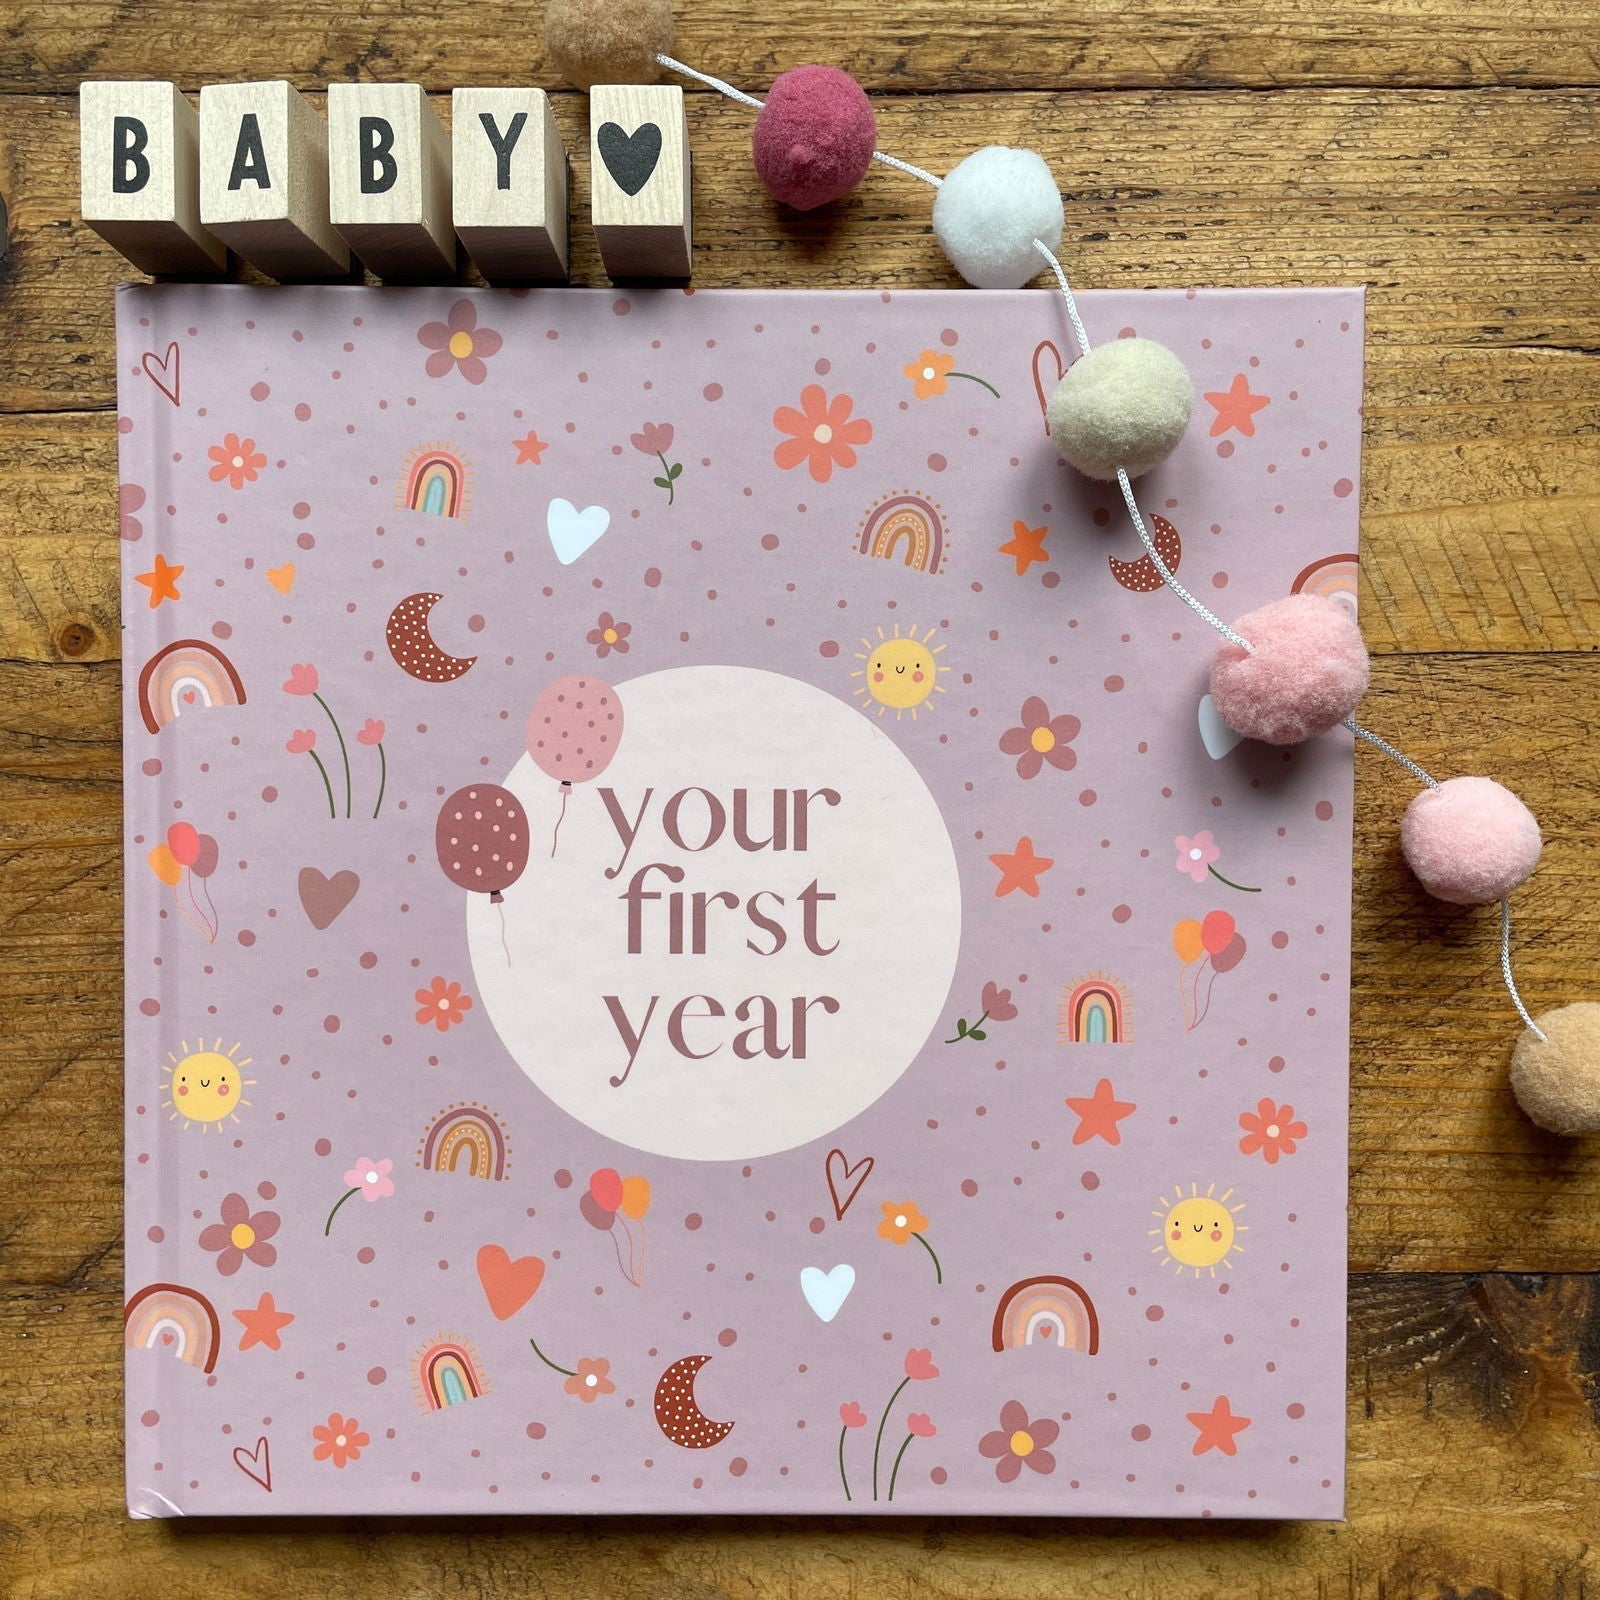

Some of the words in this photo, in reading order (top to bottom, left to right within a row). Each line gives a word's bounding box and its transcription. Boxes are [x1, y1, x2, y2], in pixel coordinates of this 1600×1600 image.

[112, 113, 529, 194] BABY
[596, 786, 842, 880] your
[617, 862, 841, 957] first
[601, 994, 841, 1088] year
